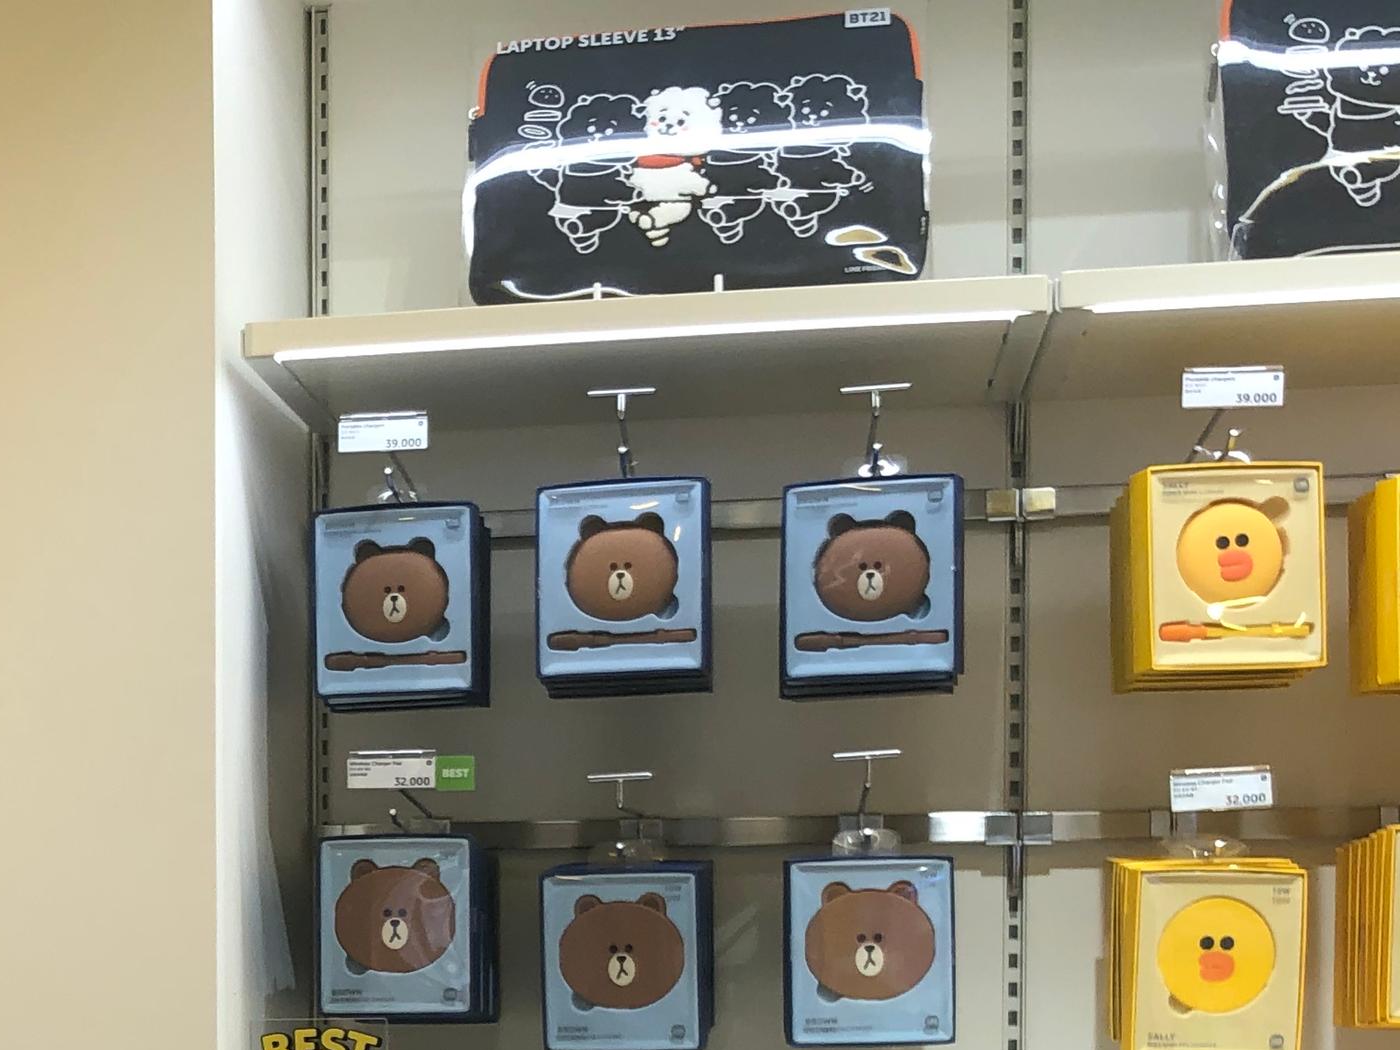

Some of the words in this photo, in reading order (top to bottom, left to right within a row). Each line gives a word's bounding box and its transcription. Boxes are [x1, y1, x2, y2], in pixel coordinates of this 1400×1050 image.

[847, 11, 887, 26] BT21
[496, 35, 574, 56] LAPTOP
[577, 30, 648, 49] SLEEVE
[441, 768, 470, 779] BEST
